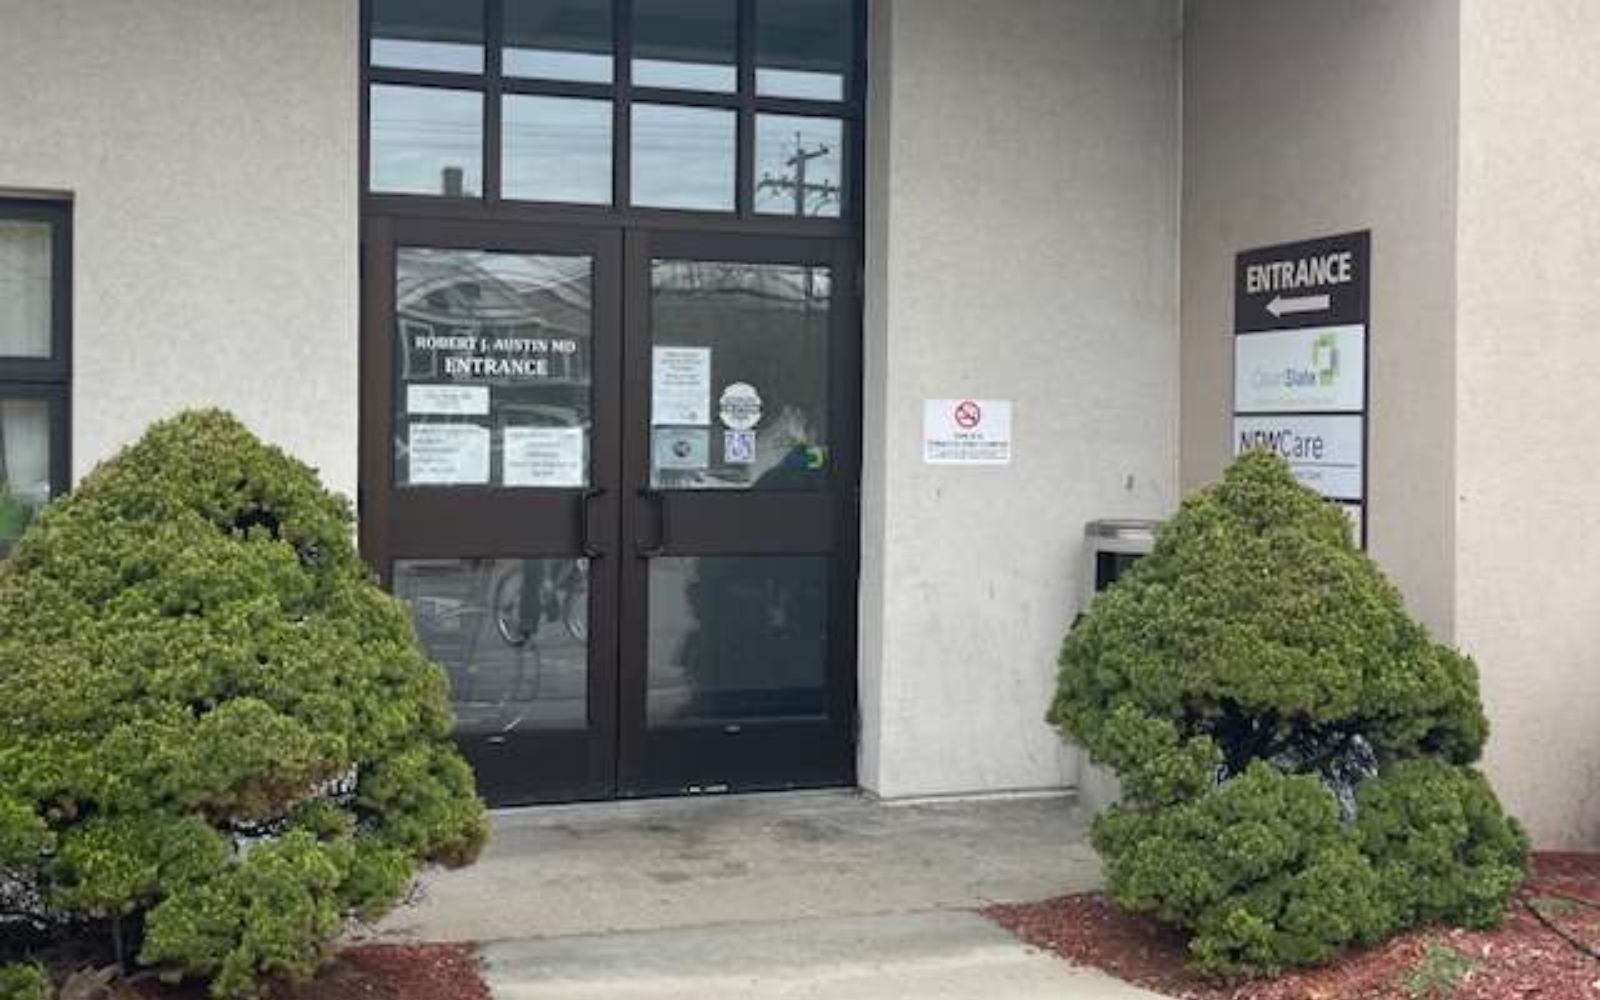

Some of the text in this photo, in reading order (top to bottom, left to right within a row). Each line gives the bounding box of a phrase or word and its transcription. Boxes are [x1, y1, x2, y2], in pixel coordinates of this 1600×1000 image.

[1246, 252, 1353, 292] ENTRANCE
[415, 335, 477, 350] ROBERT
[494, 338, 548, 352] AUSTIN
[551, 339, 577, 354] MD
[444, 356, 549, 376] ENTRANCE
